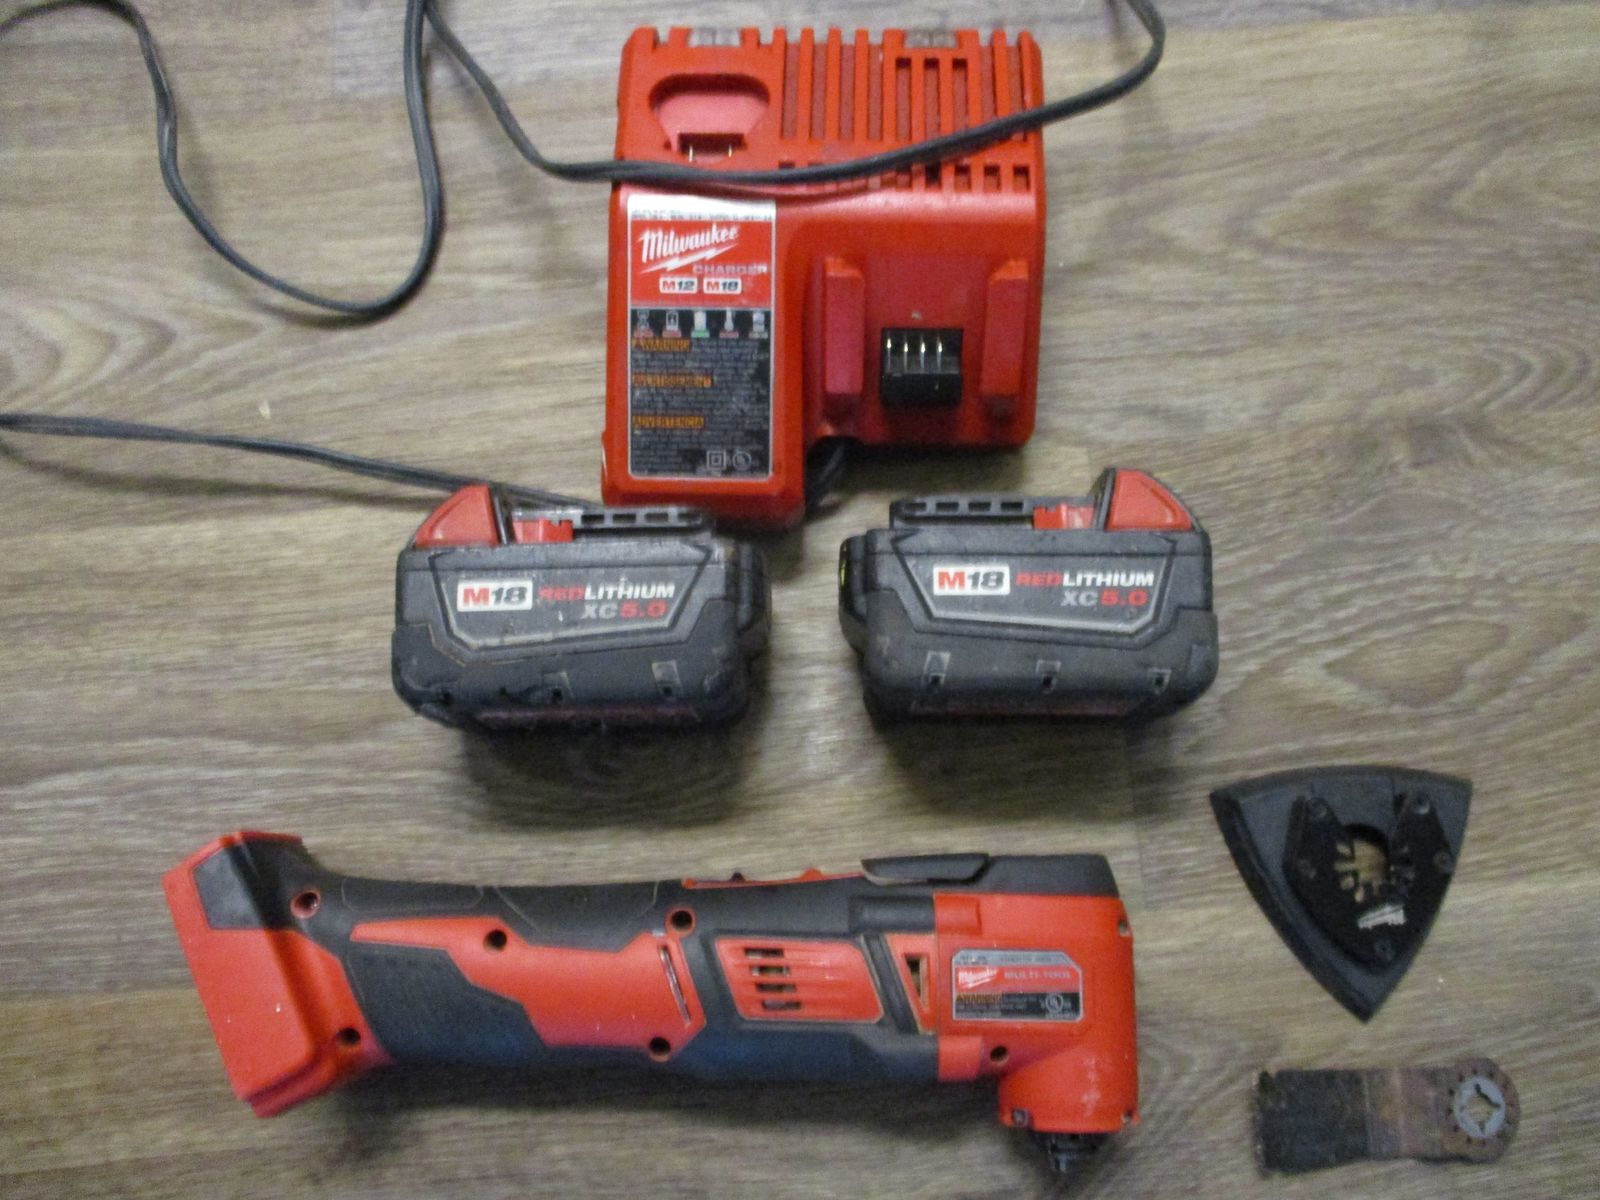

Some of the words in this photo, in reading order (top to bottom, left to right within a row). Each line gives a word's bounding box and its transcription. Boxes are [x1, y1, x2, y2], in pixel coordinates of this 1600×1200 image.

[637, 223, 739, 263] Milwaukee
[661, 279, 696, 292] M12
[706, 280, 739, 293] M18
[937, 570, 1005, 590] M18
[462, 586, 527, 606] M18
